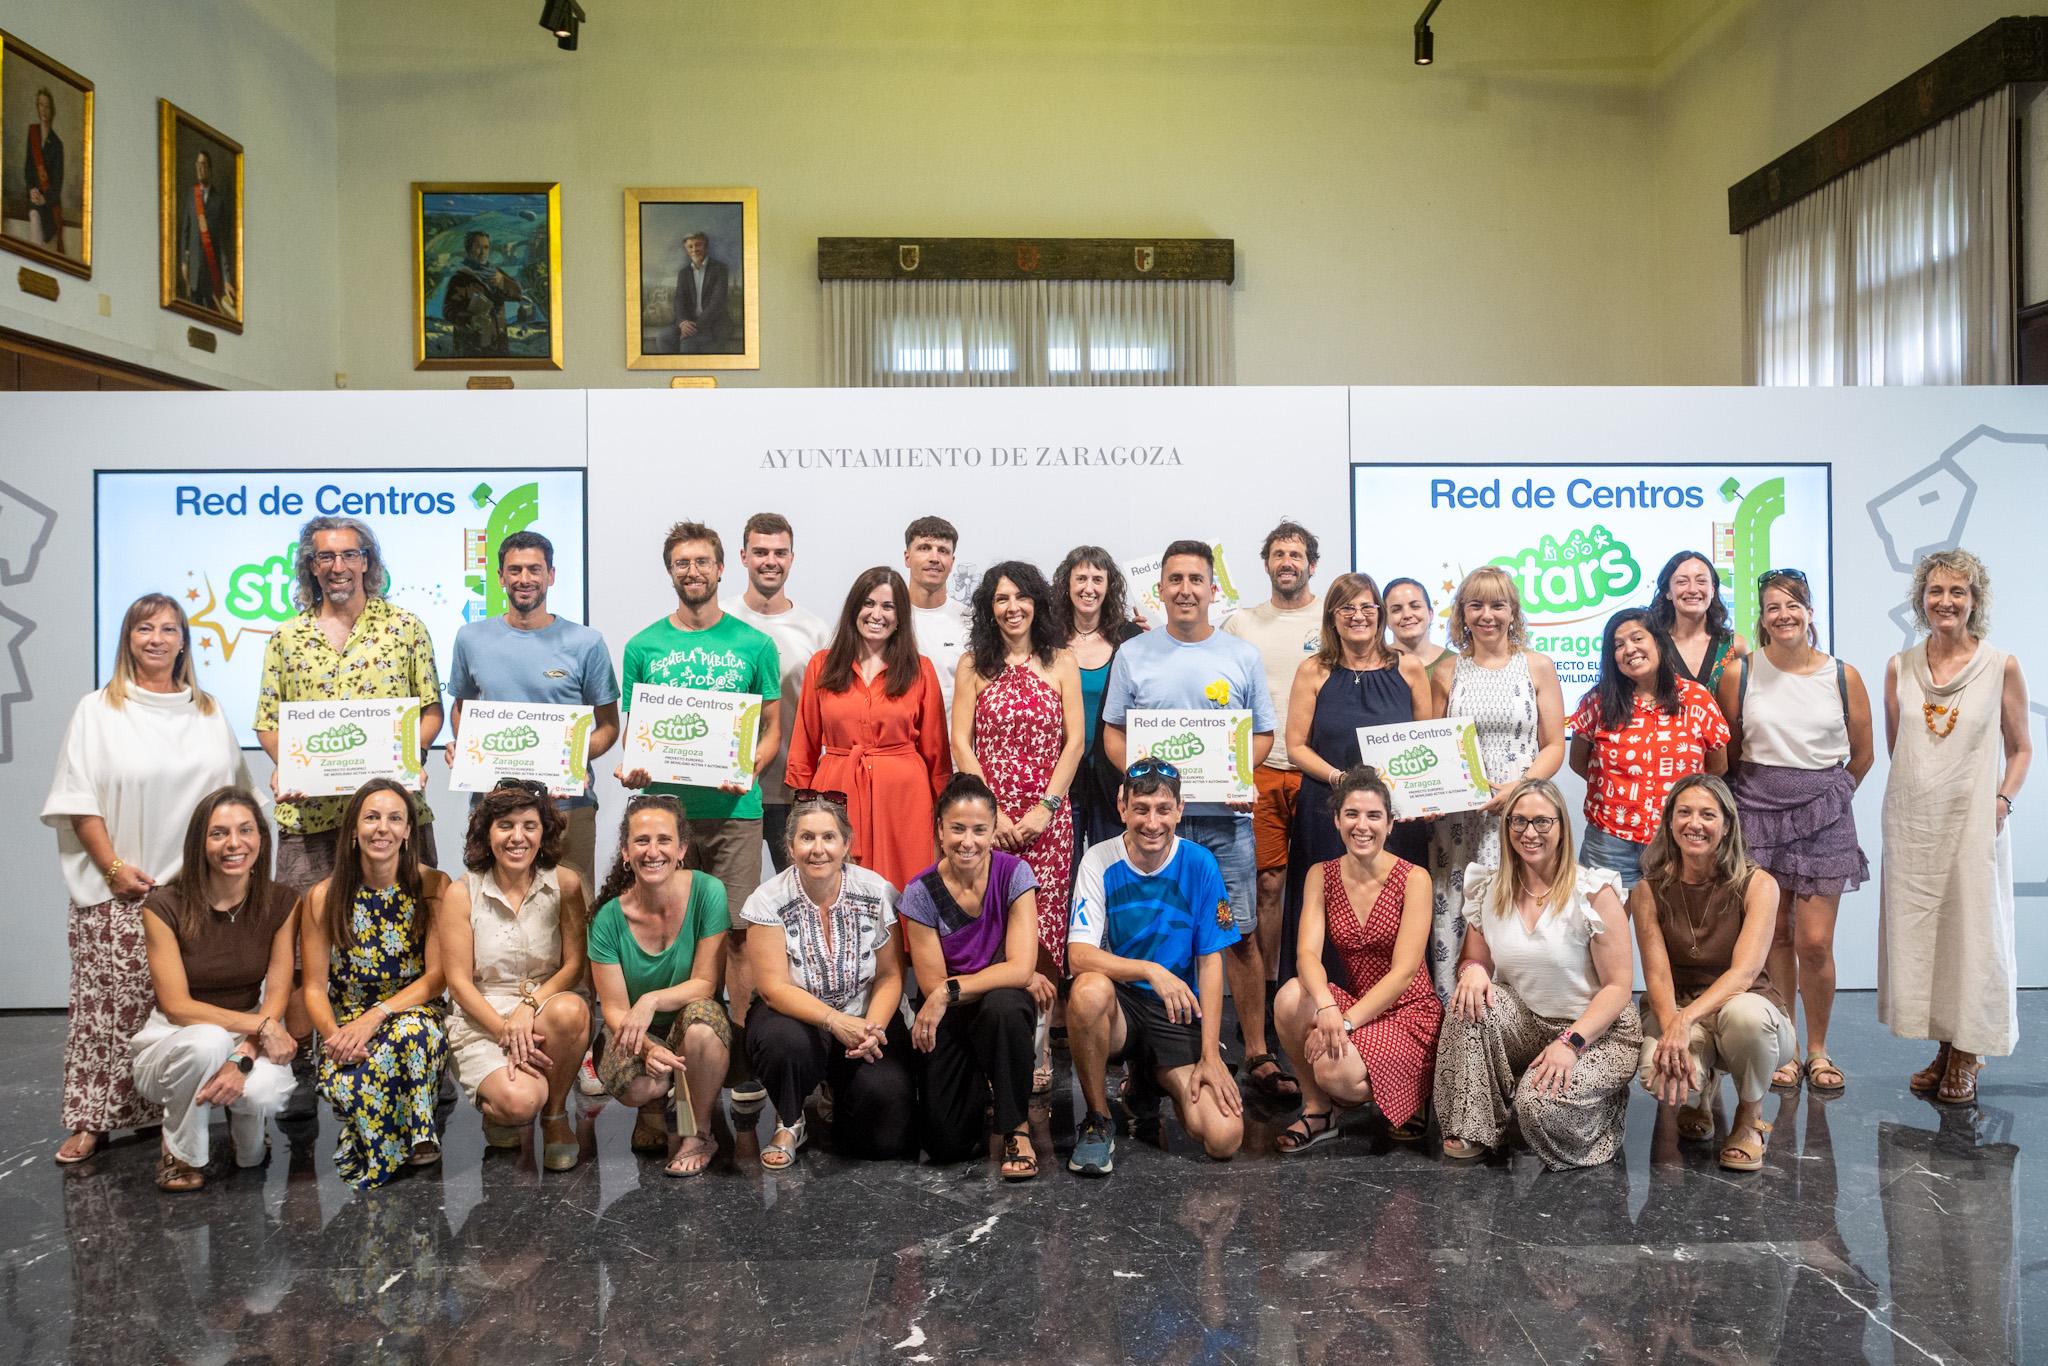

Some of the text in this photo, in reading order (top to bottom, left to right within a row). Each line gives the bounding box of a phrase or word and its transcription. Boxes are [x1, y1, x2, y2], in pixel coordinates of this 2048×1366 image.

[759, 446, 1185, 469] AYUNTAMIENTO DE ZARAGOZA
[176, 484, 456, 516] Red de Centros
[1431, 478, 1704, 509] Red de Centros
[1130, 562, 1151, 576] Red
[1526, 631, 1604, 657] arago
[650, 650, 746, 674] ESCUELA PÚBLICA:
[686, 676, 736, 689] TOD@S
[640, 692, 734, 711] Red de Centros
[288, 707, 391, 720] Red de Centros
[470, 708, 565, 722] Red de Centros
[1134, 717, 1226, 727] Red de Centros
[654, 718, 708, 740] stars
[1366, 728, 1452, 745] Red de Centros
[308, 729, 366, 752] stars
[484, 730, 538, 752] stars
[1152, 738, 1203, 760] stars
[662, 746, 704, 756] Zaragoza
[320, 758, 365, 767] Zaragoza
[492, 757, 535, 766] Zaragoza
[1390, 751, 1437, 775] stars
[1404, 779, 1441, 789] Zaragoza
